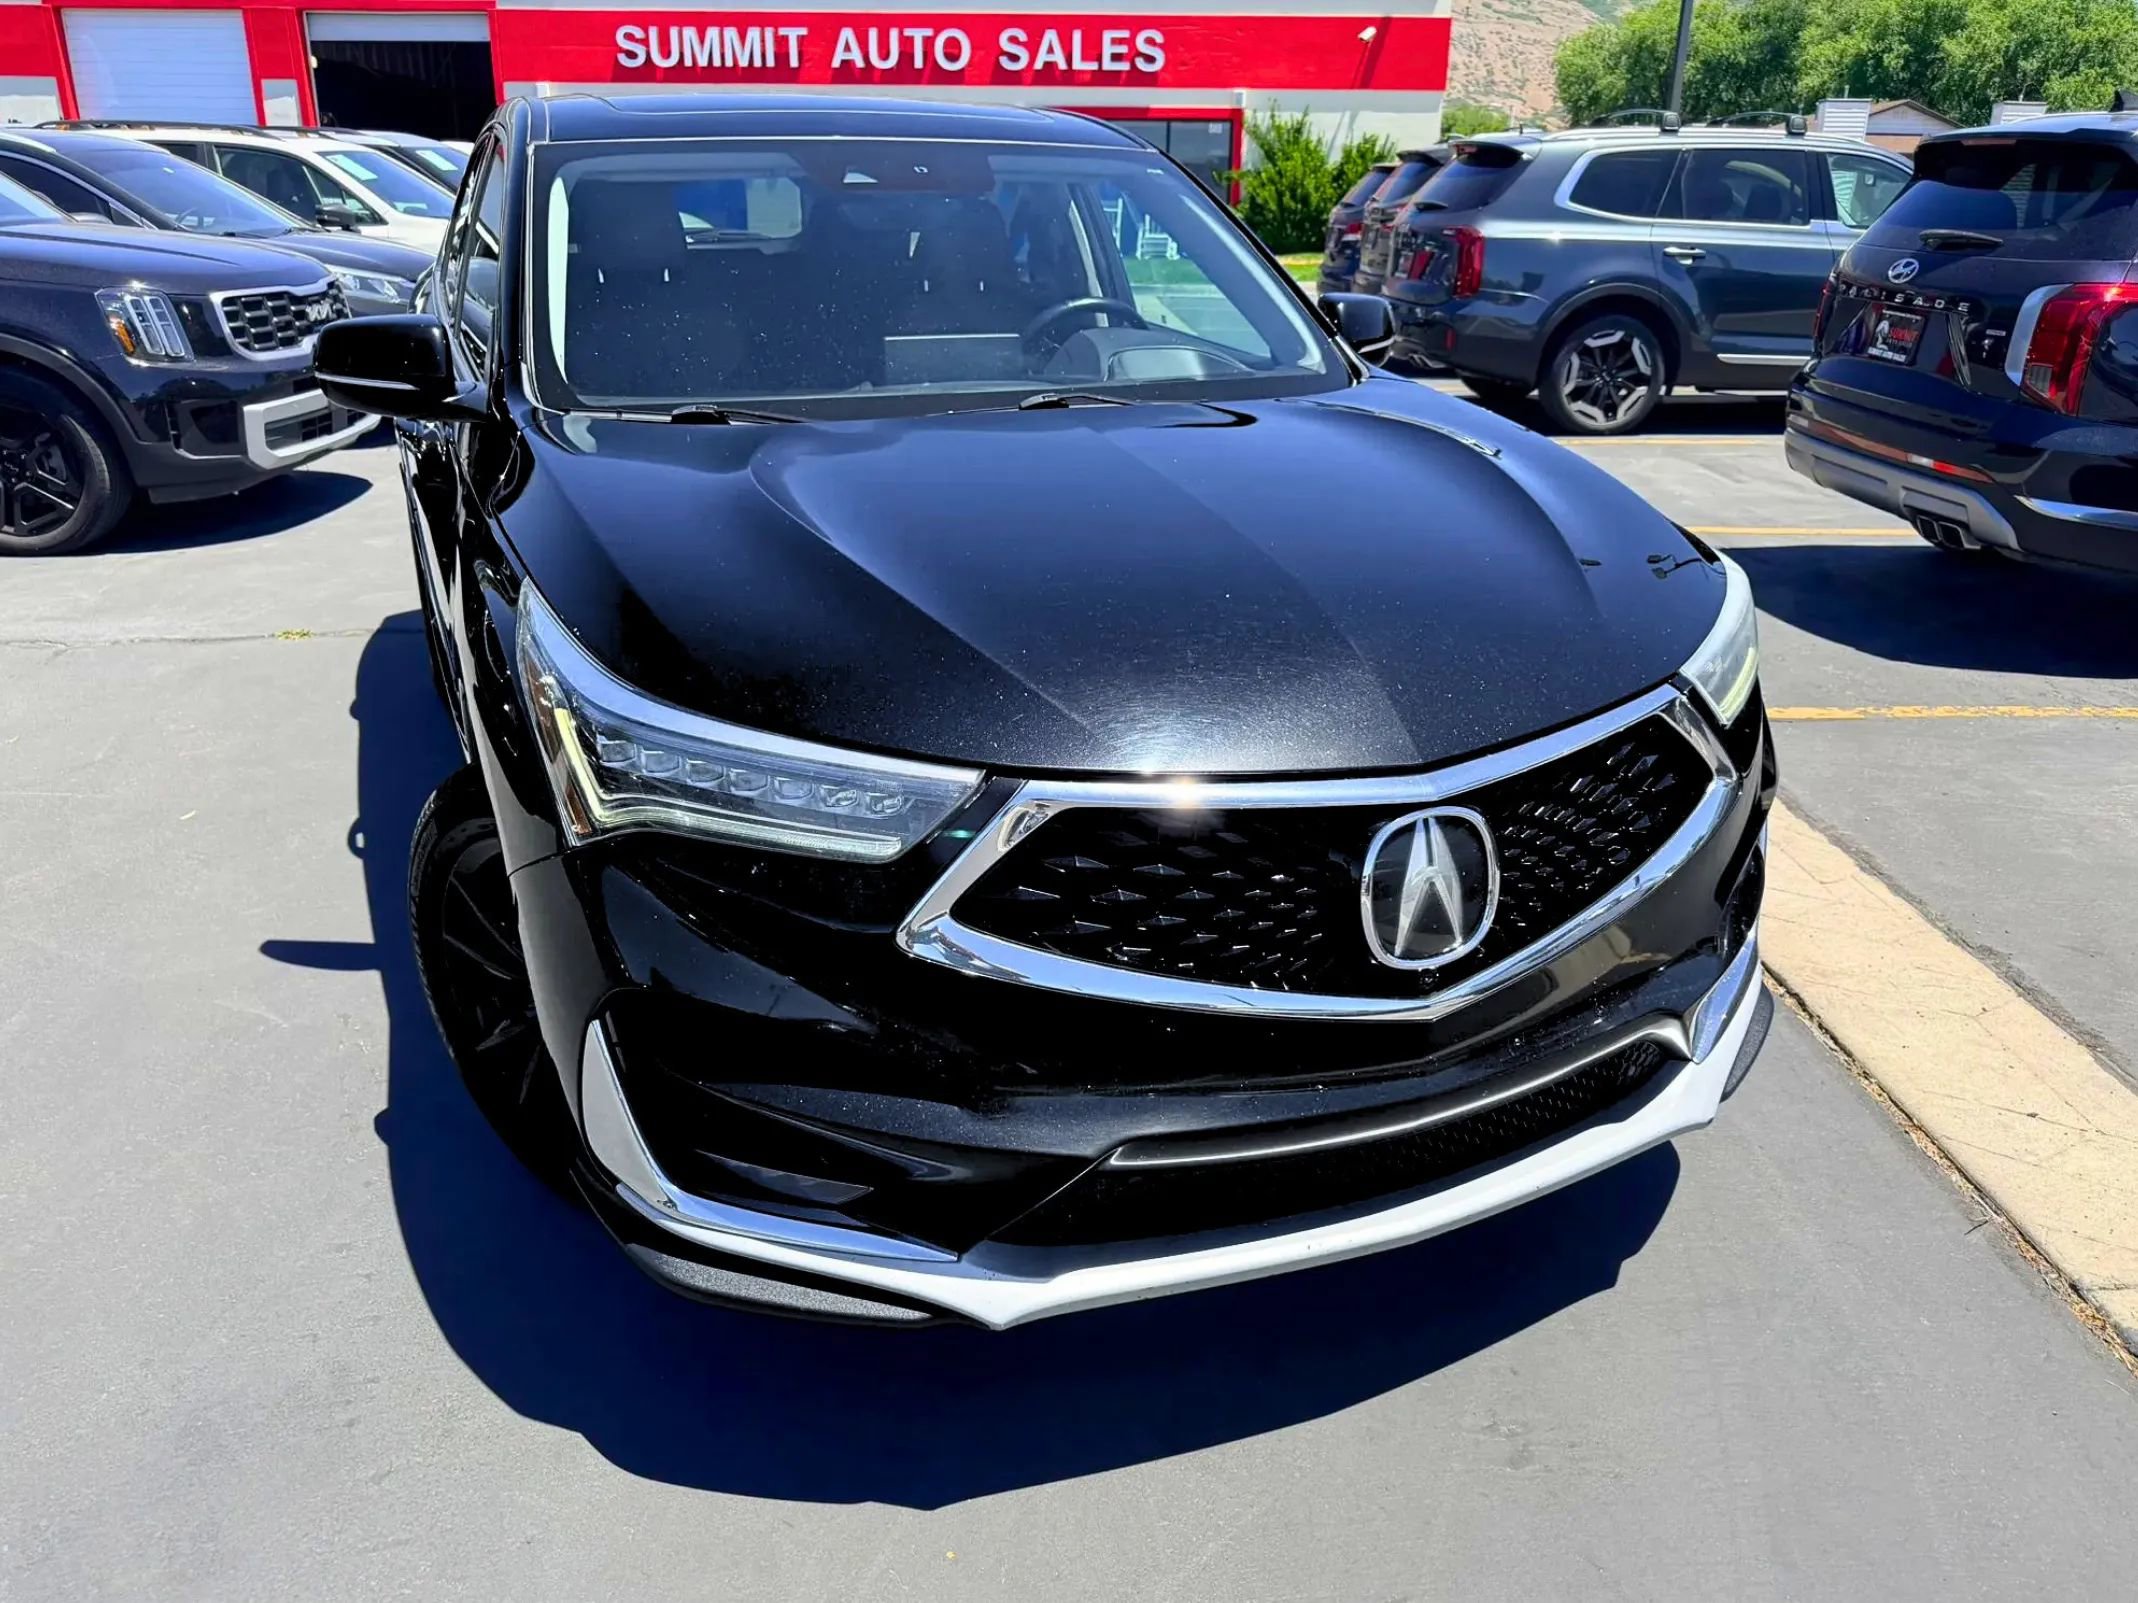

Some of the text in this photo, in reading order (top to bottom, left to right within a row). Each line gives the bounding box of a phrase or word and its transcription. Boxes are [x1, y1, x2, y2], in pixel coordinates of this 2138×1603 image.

[615, 25, 1165, 72] SUMMIT AUTO SALES
[1838, 284, 1971, 312] PALISADE
